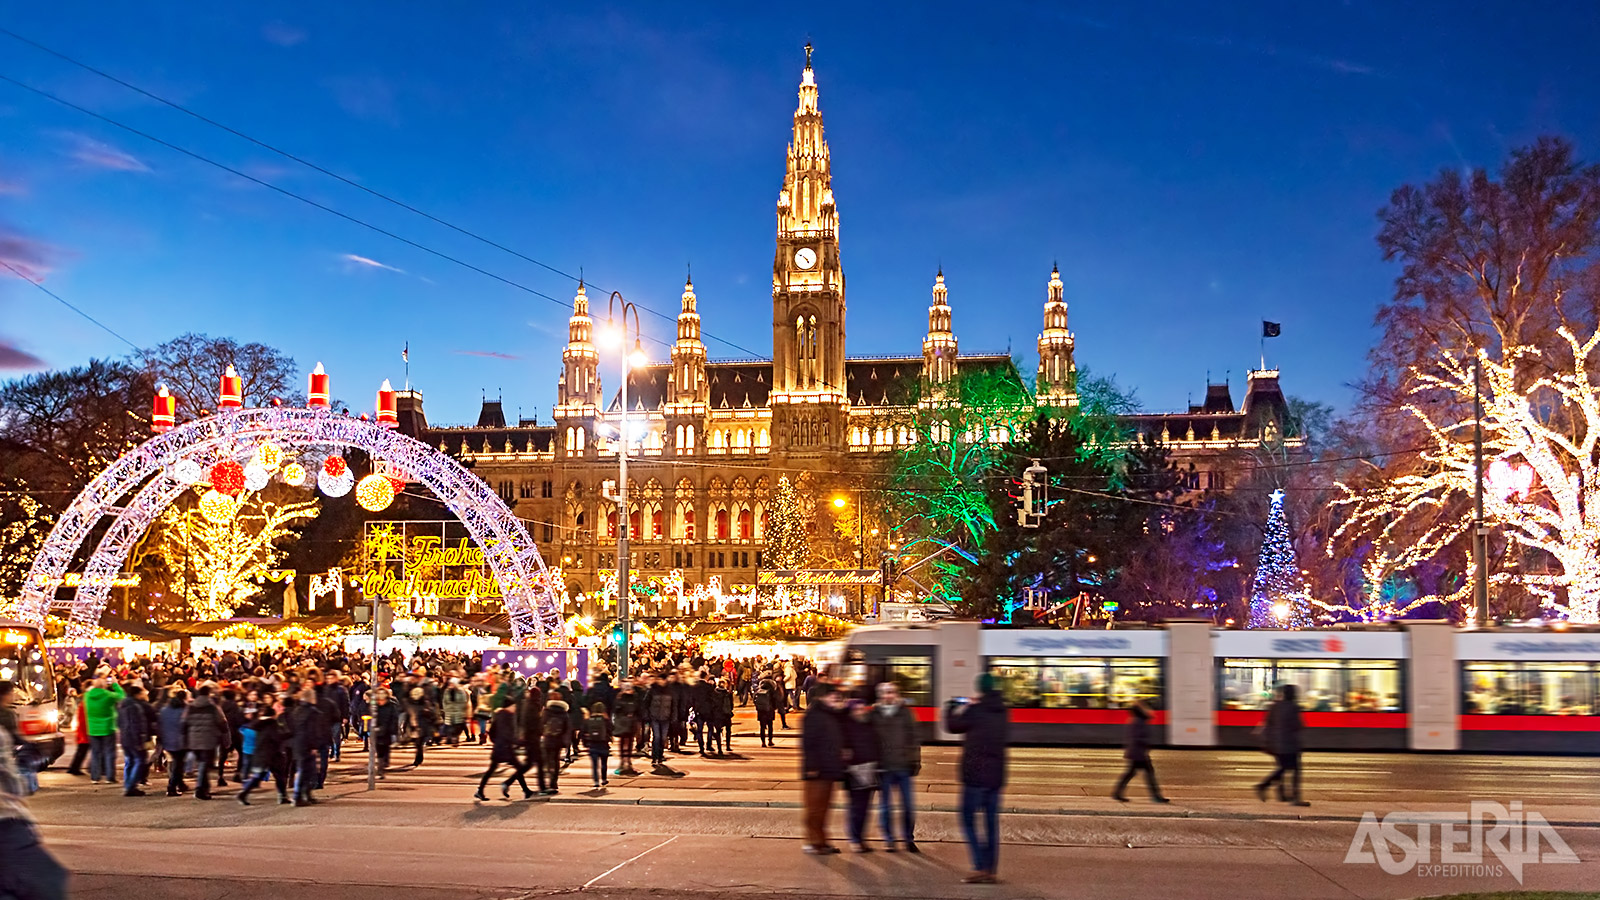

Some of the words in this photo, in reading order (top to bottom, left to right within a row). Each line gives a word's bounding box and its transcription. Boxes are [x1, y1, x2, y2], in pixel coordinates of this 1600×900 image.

[404, 535, 485, 571] Frohe
[363, 568, 517, 599] Weihnacht
[758, 571, 793, 584] Wiener
[795, 571, 882, 584] Christkindlmarkt
